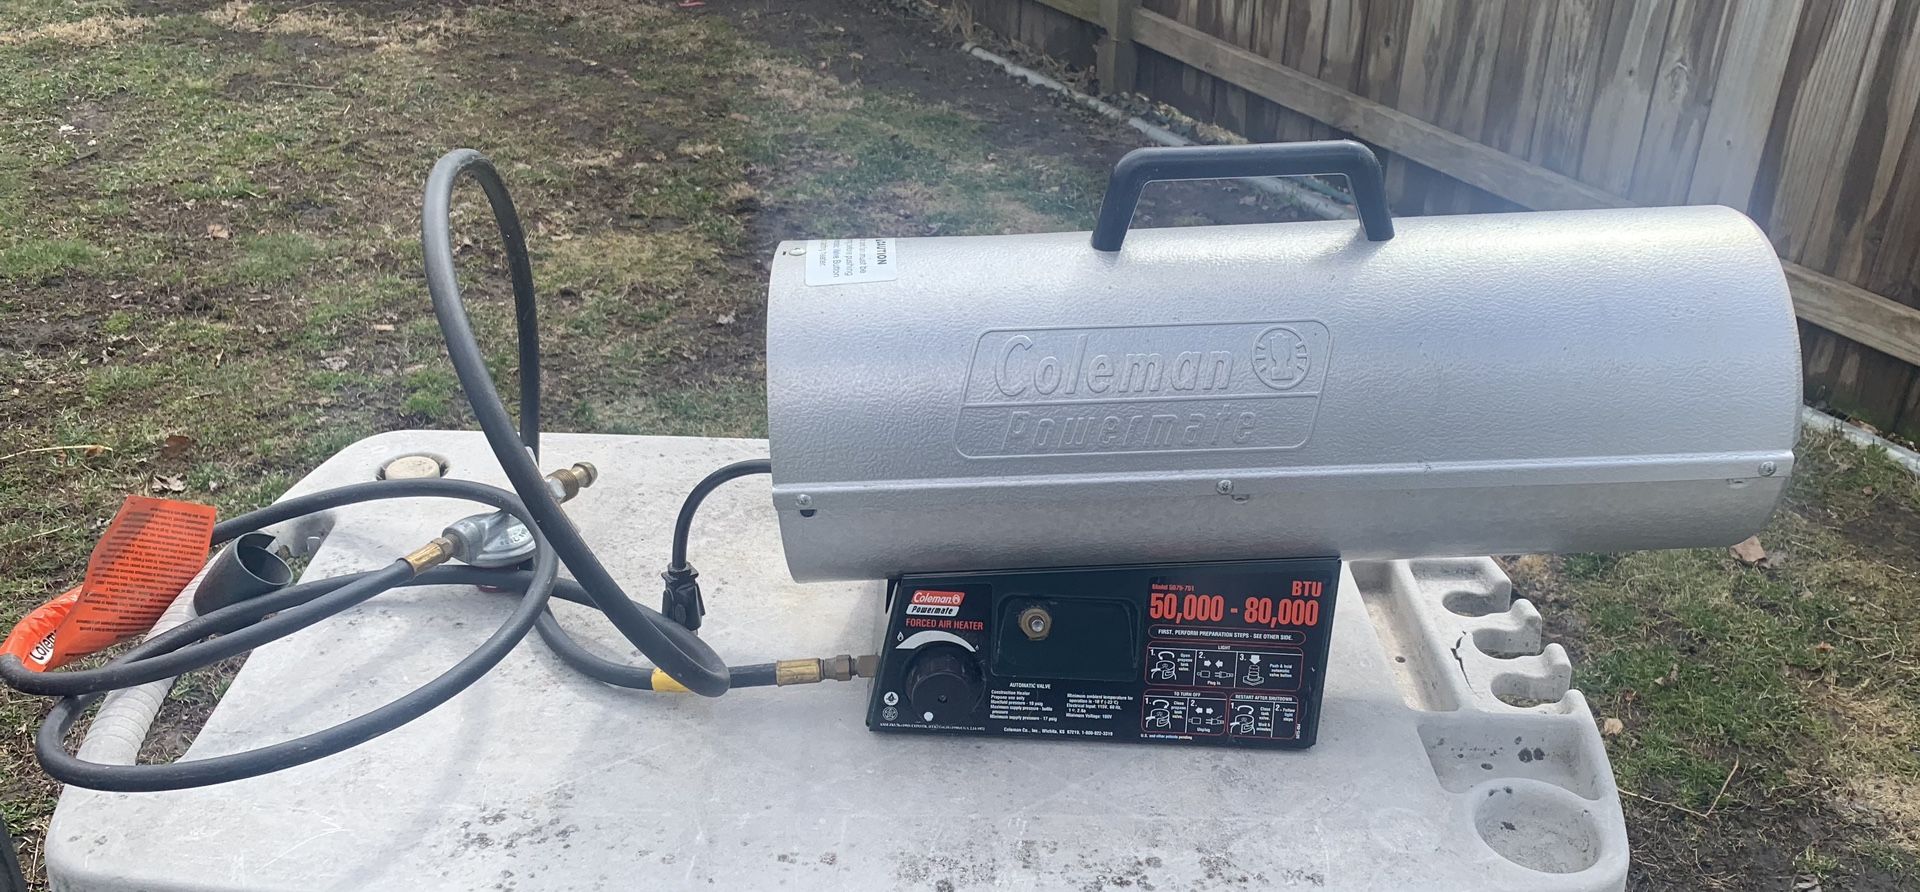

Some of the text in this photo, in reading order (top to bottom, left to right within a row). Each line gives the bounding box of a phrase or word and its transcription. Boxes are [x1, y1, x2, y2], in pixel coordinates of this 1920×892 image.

[994, 334, 1235, 397] Coleman
[1000, 404, 1256, 450] Powermate
[913, 592, 952, 604] Coleman
[1291, 580, 1323, 598] BTU
[910, 606, 954, 615] Powermate
[1150, 592, 1225, 624] 50,000
[1244, 596, 1319, 628] 80,000
[906, 618, 984, 630] FORCED AIR HEATER
[1199, 630, 1233, 638] PREPARATION
[29, 629, 57, 661] Colem
